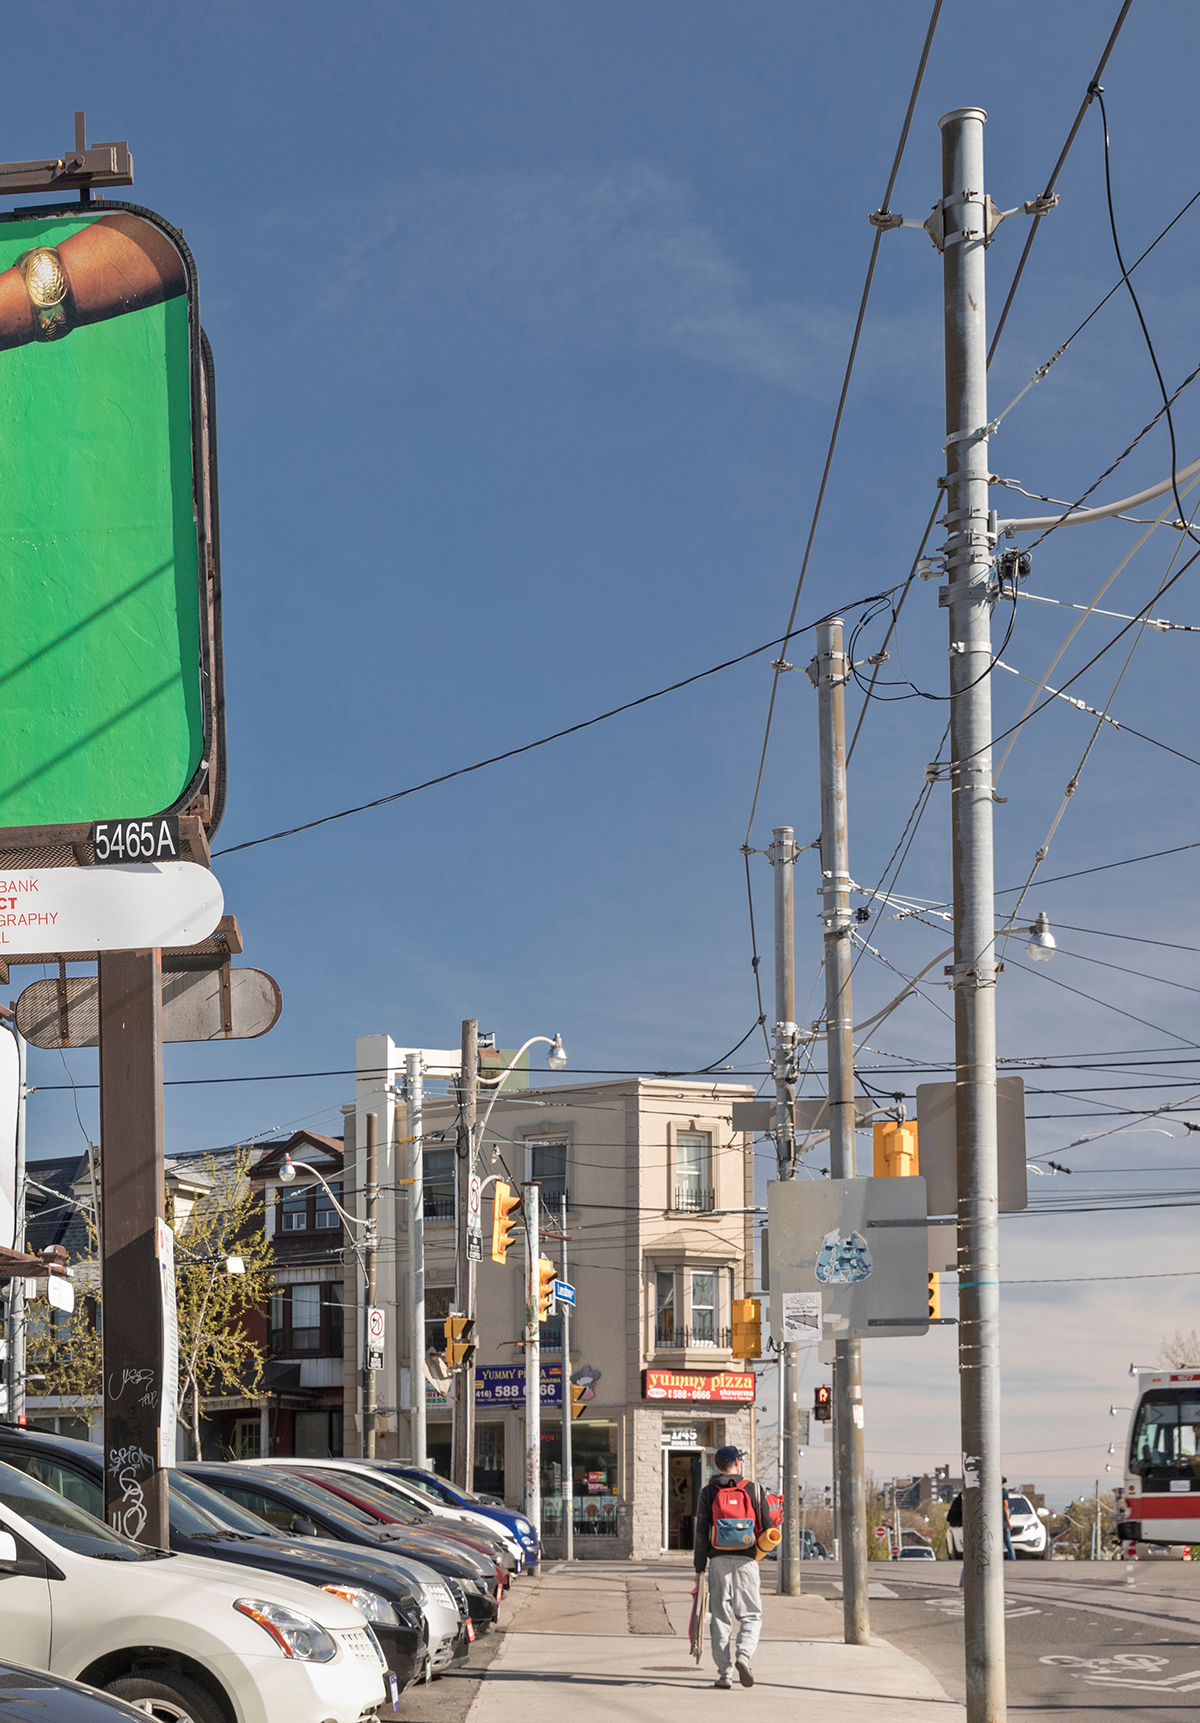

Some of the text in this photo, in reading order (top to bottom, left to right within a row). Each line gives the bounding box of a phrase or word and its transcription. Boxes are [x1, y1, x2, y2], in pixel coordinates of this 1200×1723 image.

[96, 820, 176, 860] 5465A
[482, 1369, 516, 1380] YUMMY
[517, 1369, 546, 1379] PIA
[648, 1372, 753, 1391] yummy pizza
[495, 1385, 519, 1397] 588
[671, 1428, 698, 1440] 1745
